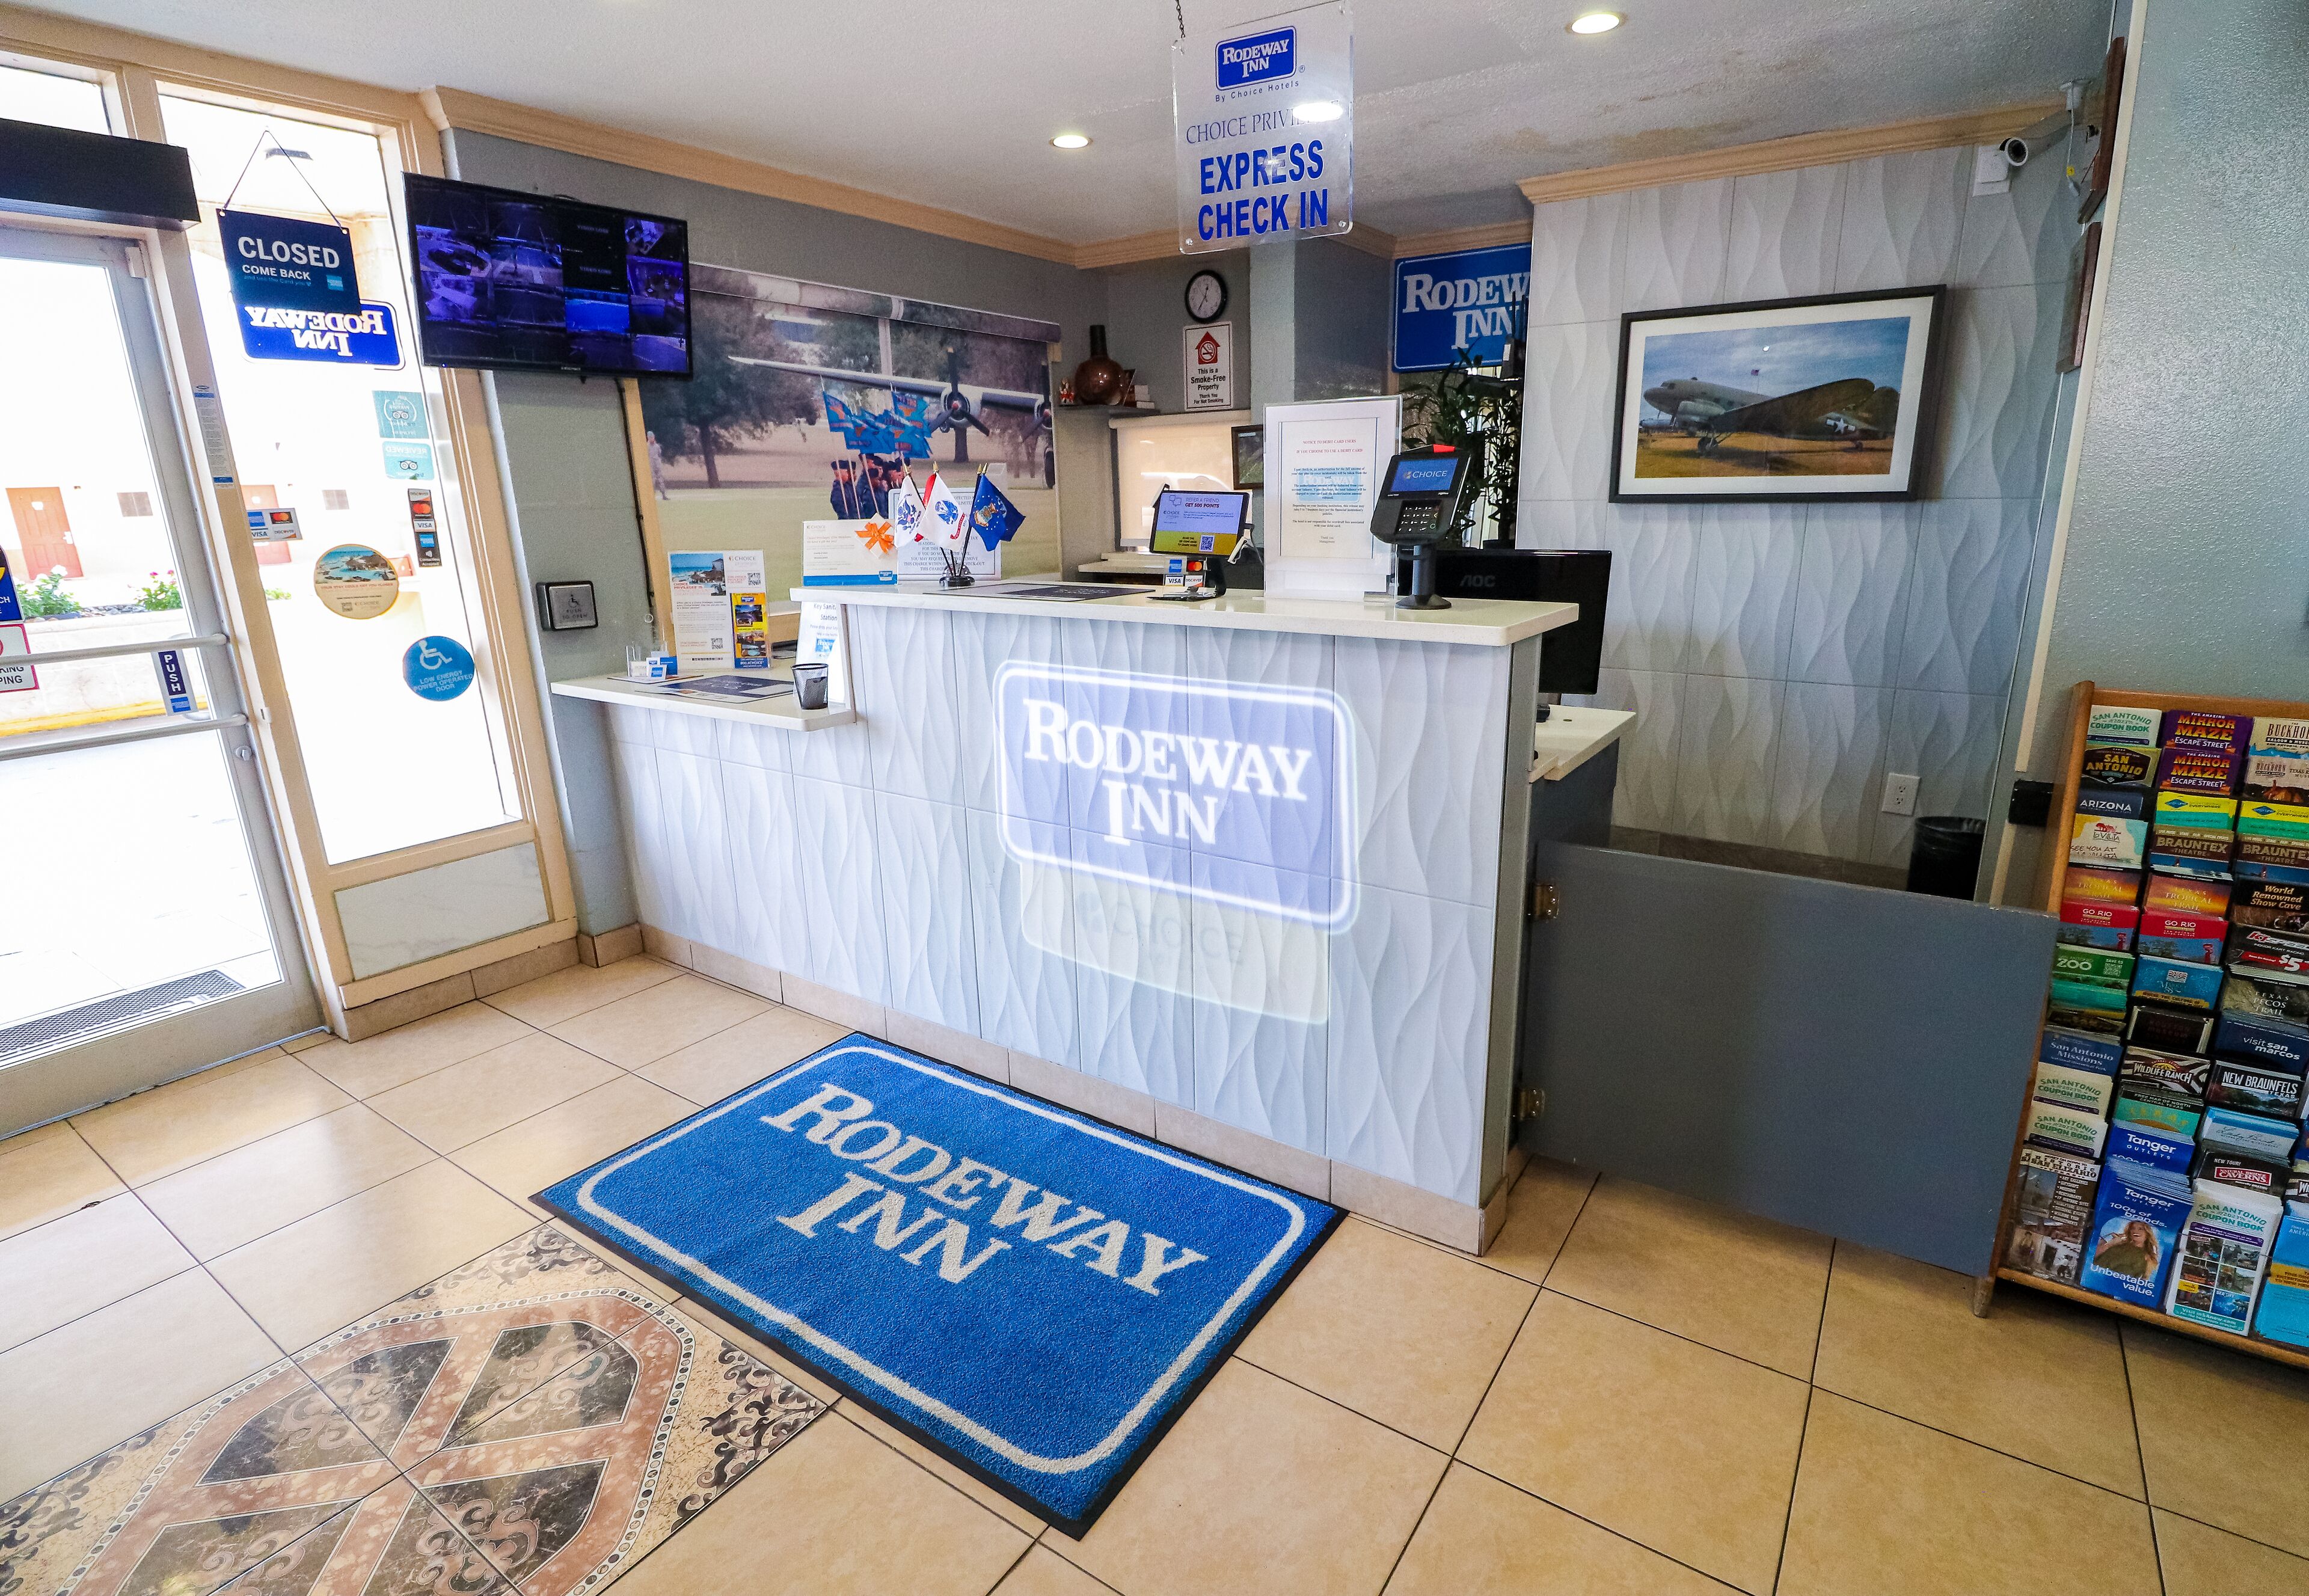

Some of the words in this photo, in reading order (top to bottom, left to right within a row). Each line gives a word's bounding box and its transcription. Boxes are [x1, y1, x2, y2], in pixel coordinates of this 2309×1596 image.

[1222, 38, 1290, 66] RODEWAY
[1242, 57, 1269, 78] INN
[1215, 94, 1225, 103] By
[1231, 87, 1263, 100] Choice
[1268, 80, 1299, 91] Hotels
[1186, 117, 1247, 144] CHOICE
[1200, 140, 1324, 195] EXPRESS
[1198, 193, 1290, 242] CHECK
[1299, 188, 1328, 229] IN
[238, 236, 340, 268] CLOSED
[242, 265, 277, 276] COME
[280, 268, 311, 280] BACK
[1191, 375, 1226, 384] Smoke-Free
[1459, 575, 1496, 588] AOC
[164, 655, 181, 692] PUSH
[2113, 713, 2152, 724] ANTONIO
[2177, 715, 2236, 729] MIRROR
[2090, 722, 2124, 731] COUPON
[2175, 725, 2234, 741] MAZE
[2175, 737, 2201, 746] ESCAPE
[1023, 698, 1312, 802] RODEWAY
[2103, 754, 2130, 764] SAN
[2174, 755, 2231, 768] MIRROR
[2086, 763, 2143, 775] ANTONIO
[2171, 764, 2228, 779] MAZE
[2171, 777, 2197, 785] ESCAPE
[2080, 799, 2132, 811] ARIZONA
[1102, 779, 1218, 847] INN
[2156, 836, 2228, 854] BRAUNTEX
[2261, 856, 2295, 865] THEATRE
[2252, 891, 2303, 903] Renowned
[2265, 885, 2294, 895] World
[2165, 892, 2212, 904] TROPICAL
[2250, 898, 2277, 907] Show
[2279, 901, 2302, 910] Cave
[2174, 902, 2200, 912] TRAIL
[2056, 958, 2092, 971] ZOO
[2278, 954, 2304, 971] $5
[2254, 998, 2286, 1008] PECOS
[2255, 991, 2289, 1001] TEXAS
[2255, 1006, 2284, 1016] TRAIL
[2050, 1042, 2069, 1052] San
[2071, 1046, 2114, 1061] Antonio
[2243, 1037, 2266, 1046] visit
[2267, 1042, 2289, 1052] san
[2058, 1051, 2103, 1066] Missions
[2254, 1046, 2301, 1060] marcos
[2133, 1063, 2164, 1077] WILDLIFE
[2165, 1069, 2193, 1084] RANCH
[2061, 1080, 2101, 1096] ANTONIO
[2222, 1071, 2244, 1085] NEW
[2245, 1075, 2298, 1094] BRAUNFELS
[2038, 1085, 2073, 1097] COUPON
[2074, 1092, 2099, 1103] BOOK
[2139, 1097, 2165, 1106] CENTRAL
[2034, 1122, 2069, 1136] COUPON
[2070, 1131, 2096, 1143] BOOK
[2058, 1117, 2097, 1135] ANTONIO
[2127, 1134, 2176, 1153] Tanger
[2127, 1144, 2170, 1159] OUTLETS
[2031, 1158, 2050, 1167] SAN
[2052, 1163, 2096, 1178] ELIZARIO
[2035, 1155, 2095, 1171] HISTORIC
[2219, 1173, 2266, 1183] CAVERNS
[760, 1082, 1208, 1297] RODEWAY
[2124, 1196, 2168, 1211] OUTLETS
[2125, 1188, 2174, 1208] Tanger
[2110, 1203, 2136, 1213] 100s
[2222, 1205, 2266, 1225] ANTONIO
[2124, 1211, 2167, 1227] brands.
[2196, 1211, 2235, 1225] COUPON
[2237, 1220, 2264, 1232] BOOK
[776, 1171, 1013, 1284] INN
[2090, 1263, 2154, 1289] Unbeatable
[2123, 1282, 2154, 1297] value.
